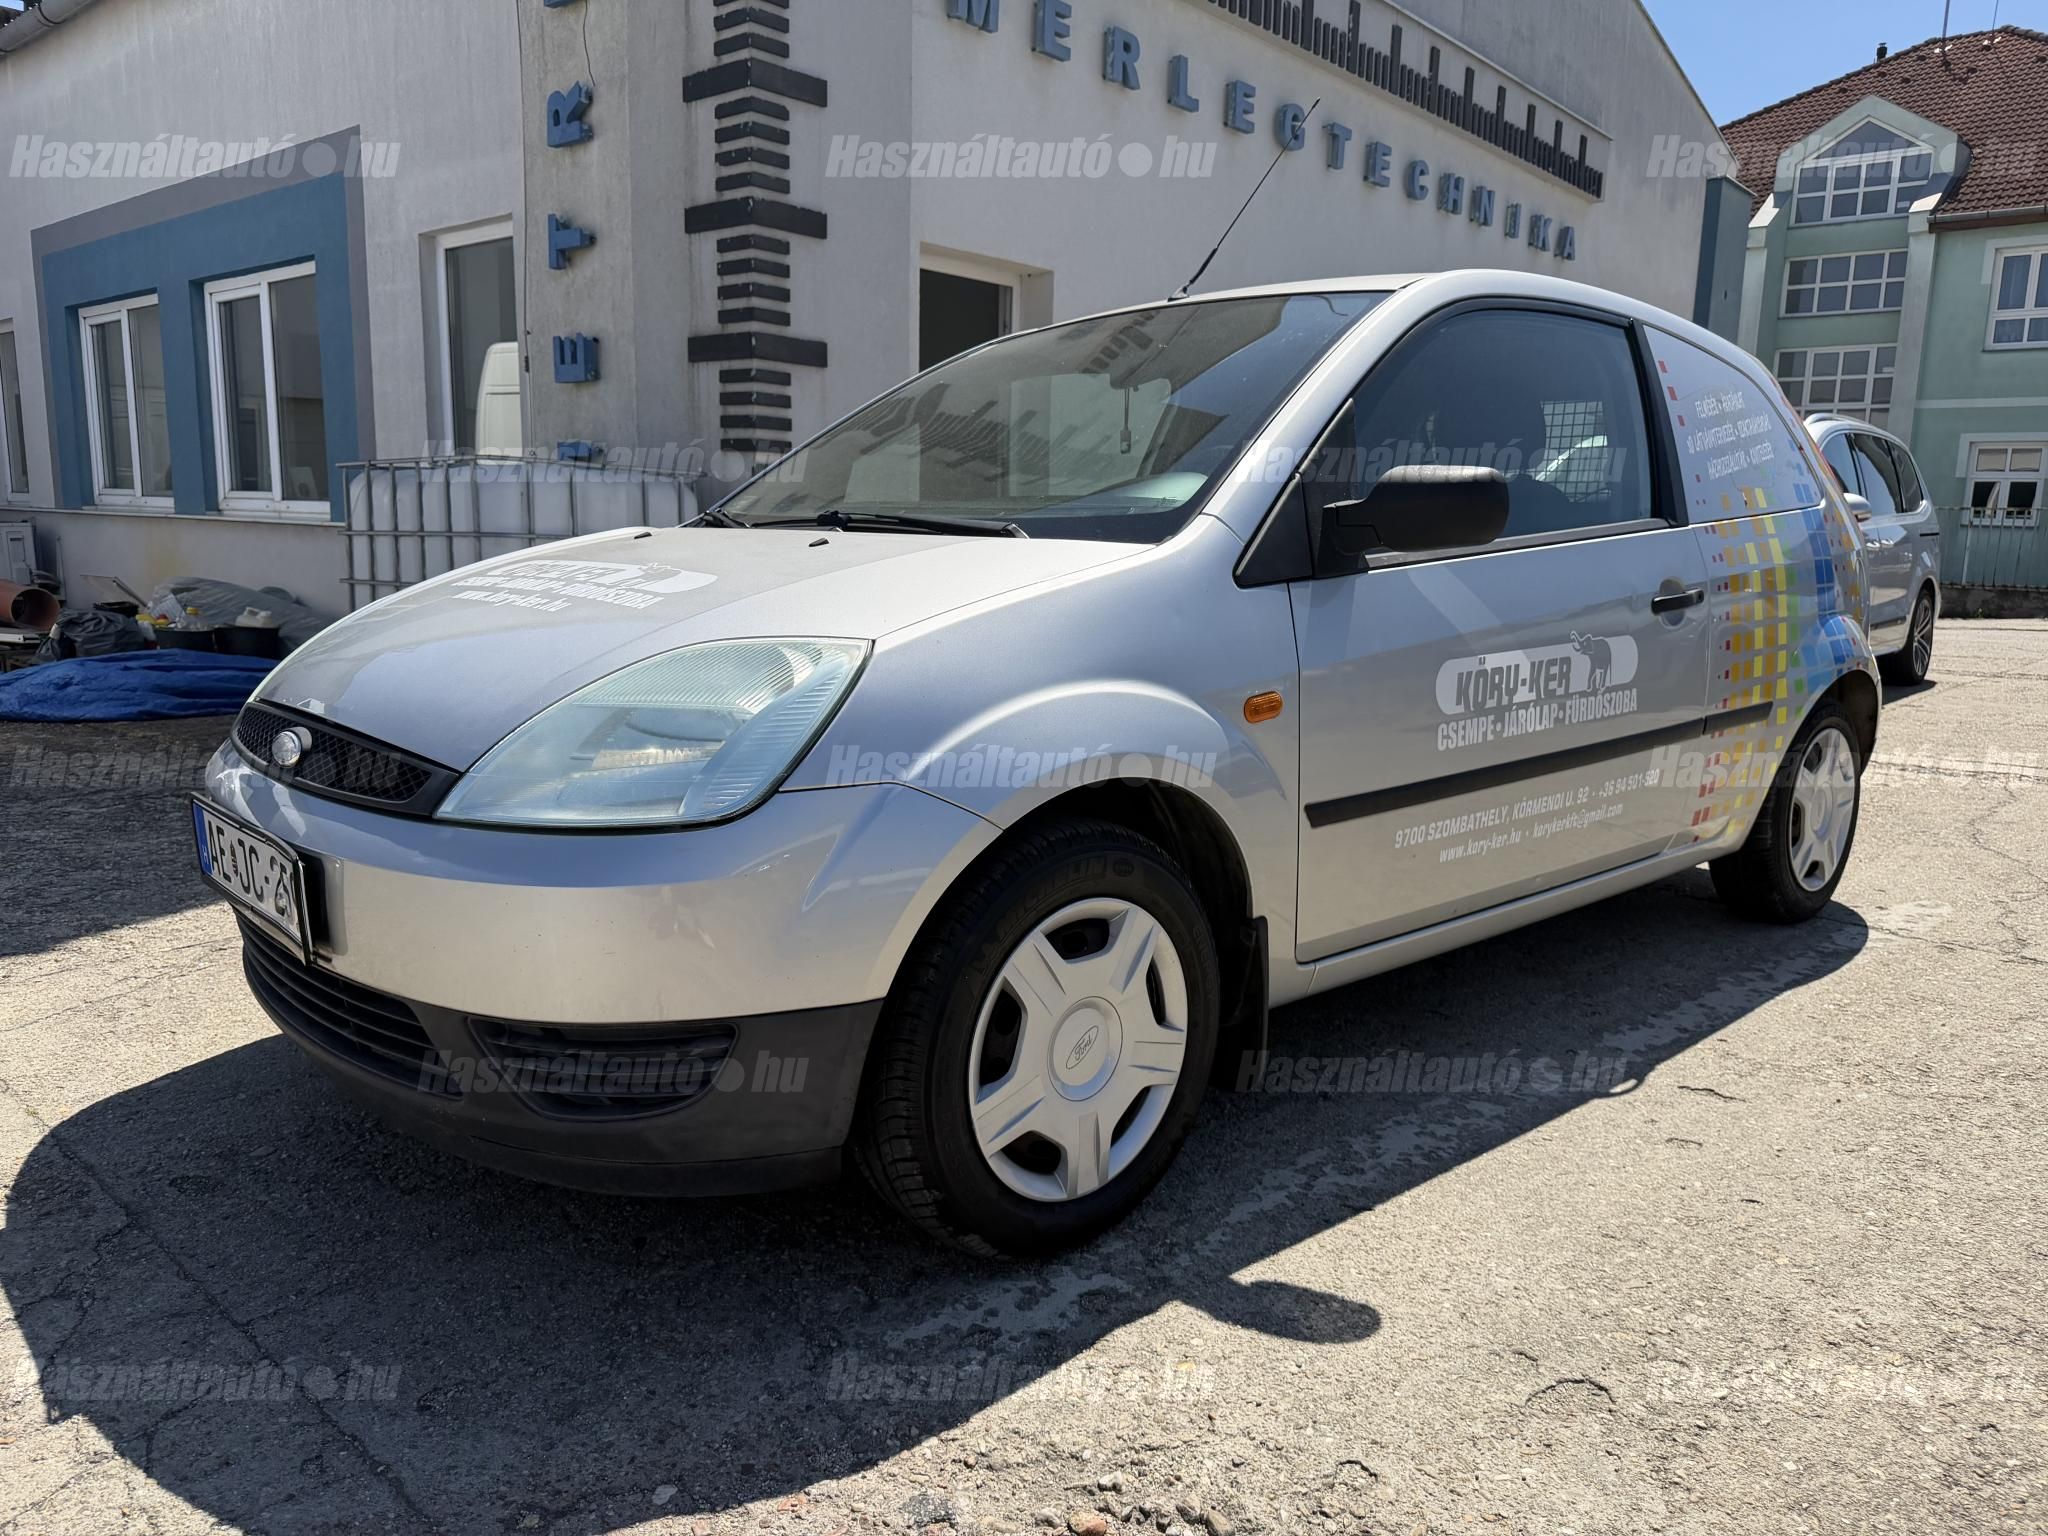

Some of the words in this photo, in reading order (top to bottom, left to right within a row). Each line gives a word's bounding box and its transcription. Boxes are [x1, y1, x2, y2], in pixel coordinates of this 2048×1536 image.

[1437, 715, 1495, 751] CSEMPE
[1502, 702, 1558, 738] JÁRÓLAP
[1565, 688, 1638, 725] FÜRDŐSZOBA
[1394, 823, 1426, 849] 9700
[1577, 786, 1589, 804] 92
[1439, 828, 1521, 863] www.kory-ker.hu
